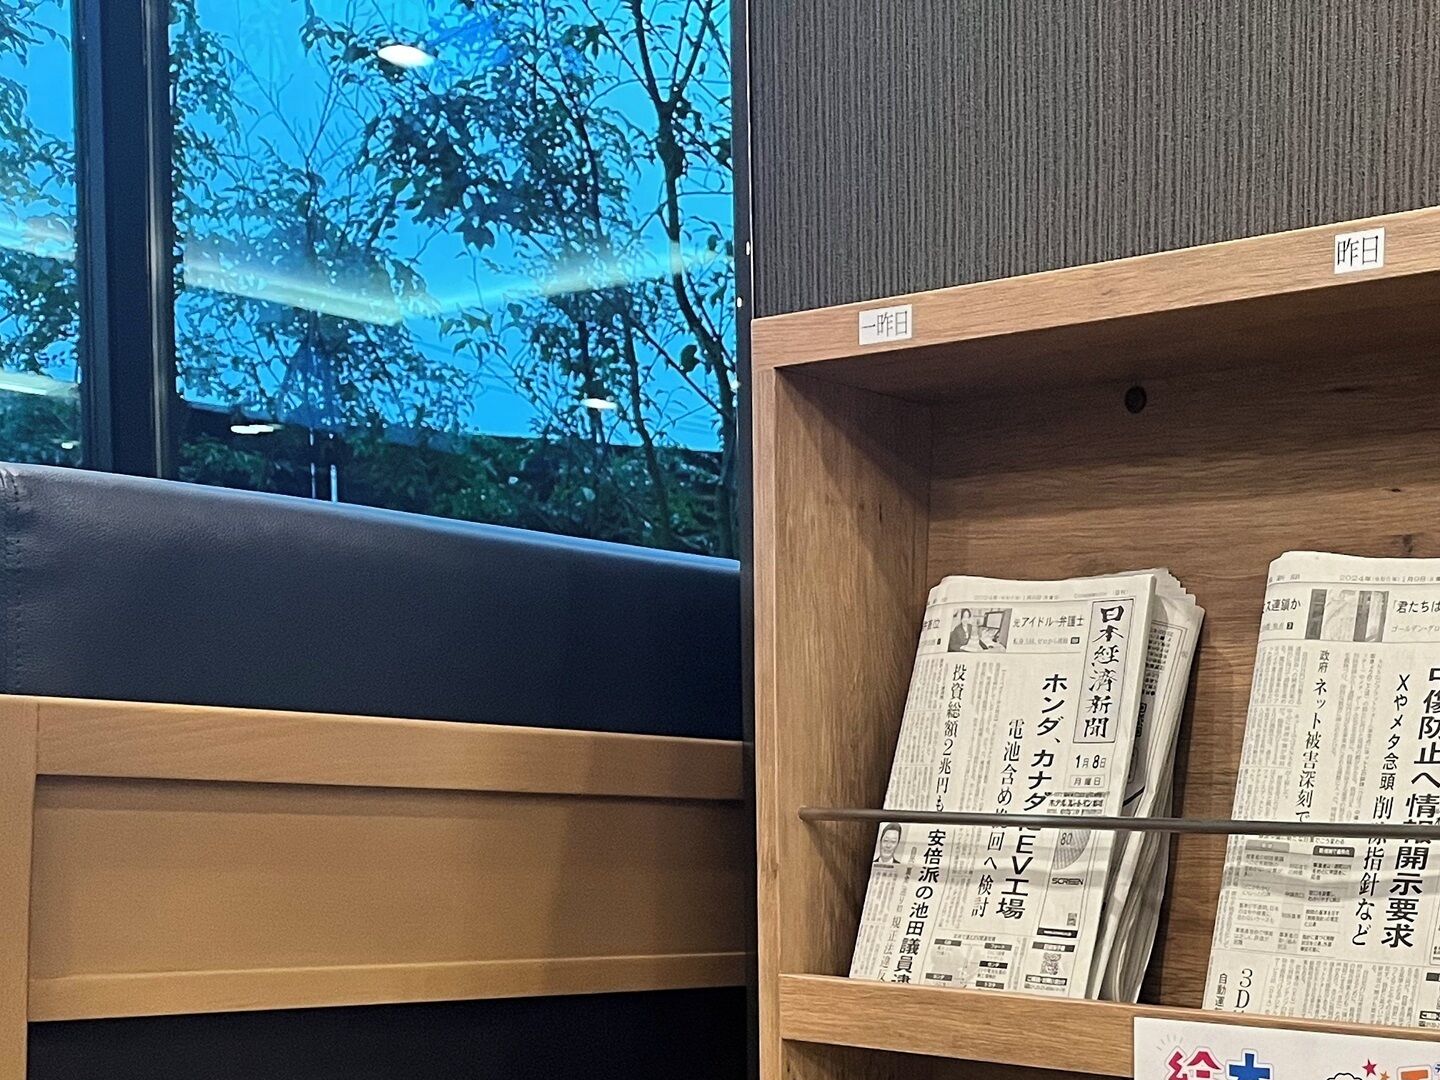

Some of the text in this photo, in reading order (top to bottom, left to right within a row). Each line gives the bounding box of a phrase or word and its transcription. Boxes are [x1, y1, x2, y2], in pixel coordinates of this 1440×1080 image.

[1337, 235, 1379, 267] 昨日
[861, 311, 908, 337] 一昨日
[935, 662, 967, 813] 投資総額2兆円も
[1295, 649, 1330, 823] 政府 ネット被害深刻で
[1379, 673, 1411, 791] Xやメタ念頭
[1075, 754, 1107, 769] 1月8日
[1051, 876, 1084, 886] SCREEN
[1235, 967, 1253, 1014] 3D
